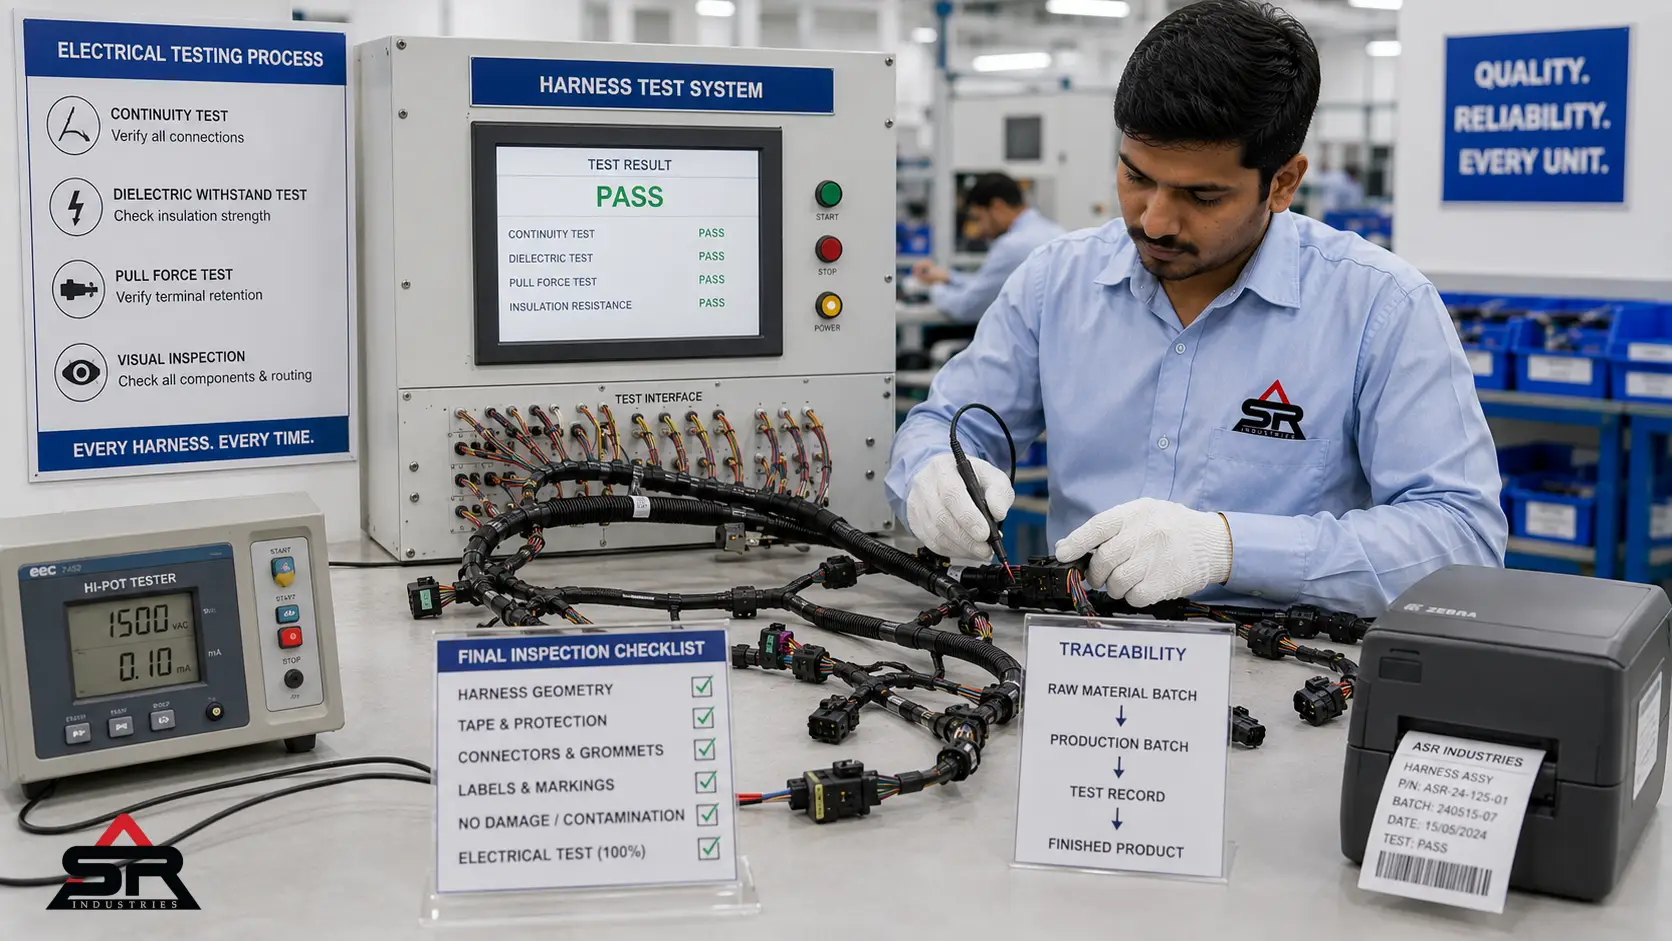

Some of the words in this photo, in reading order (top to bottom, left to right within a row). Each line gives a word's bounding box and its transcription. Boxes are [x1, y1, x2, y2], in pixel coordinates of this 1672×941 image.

[58, 41, 166, 62] ELECTRICAL
[171, 46, 243, 65] TESTING
[248, 49, 324, 67] PROCESS
[1474, 56, 1590, 90] QUALITY.
[540, 76, 632, 96] HARNESS
[637, 78, 685, 98] TEST
[689, 79, 763, 99] SYSTEM
[111, 107, 191, 122] CONTINUITY
[196, 109, 228, 122] TEST
[1454, 102, 1611, 132] RELIABILITY.
[112, 130, 148, 145] Verify
[151, 130, 166, 143] all
[169, 130, 244, 144] connections
[588, 159, 620, 171] TEST
[624, 159, 672, 171] RESULT
[1459, 148, 1539, 176] EVERY
[1543, 146, 1610, 175] UNIT.
[113, 188, 192, 201] DIELECTRIC
[196, 188, 272, 201] WITHSTAND
[276, 188, 307, 201] TEST
[596, 185, 664, 208] PASS
[114, 210, 154, 222] Check
[158, 209, 217, 222] insulation
[221, 210, 271, 224] strength
[816, 213, 839, 221] START
[508, 229, 568, 240] CONTINUITY
[571, 229, 595, 240] TEST
[698, 228, 725, 238] PASS
[509, 253, 566, 264] DIELECTRIC
[568, 252, 593, 264] TEST
[698, 251, 725, 262] PASS
[116, 269, 149, 282] PULL
[153, 269, 197, 281] FORCE
[201, 268, 233, 281] TEST
[698, 274, 725, 285] PASS
[818, 268, 838, 276] STOP
[509, 277, 534, 288] PULL
[538, 277, 569, 288] FORCE
[572, 277, 597, 288] TEST
[116, 290, 152, 305] Verify
[155, 289, 205, 302] terminal
[209, 288, 263, 302] retention
[698, 298, 725, 308] PASS
[509, 301, 568, 312] INSULATION
[572, 300, 632, 311] RESISTANCE
[814, 324, 841, 332] POWER
[118, 353, 165, 366] VISUAL
[169, 350, 246, 364] INSPECTION
[118, 373, 159, 387] Check
[163, 372, 177, 386] all
[180, 371, 256, 388] components
[259, 370, 268, 382] &
[271, 368, 313, 383] routing
[616, 393, 642, 404] TEST
[646, 391, 702, 404] INTERFACE
[73, 441, 128, 458] EVERY
[133, 436, 214, 455] HARNESS.
[219, 433, 270, 450] EVERY
[274, 430, 315, 447] TIME.
[29, 565, 56, 577] eec
[84, 579, 127, 593] HI-POT
[130, 573, 177, 588] TESTER
[1425, 606, 1477, 618] ZEBRA
[110, 604, 168, 638] 1500
[172, 621, 189, 631] VAC
[208, 648, 222, 657] mA
[458, 648, 506, 664] FINAL
[511, 644, 610, 661] INSPECTION
[614, 640, 705, 658] CHECKLIST
[1060, 642, 1187, 661] TRACEABILITY
[119, 648, 172, 682] 0.10
[177, 663, 192, 674] mA
[459, 686, 528, 701] HARNESS
[533, 684, 614, 699] GEOMETRY
[1048, 684, 1078, 696] RAW
[1082, 685, 1148, 699] MATERIAL
[1152, 688, 1197, 702] BATCH
[459, 718, 495, 732] TAPE
[500, 718, 510, 730] &
[514, 715, 608, 730] PROTECTION
[1050, 734, 1139, 750] PRODUCTION
[1144, 739, 1189, 752] BATCH
[459, 749, 560, 764] CONNECTORS
[566, 748, 575, 760] &
[580, 744, 664, 760] GROMMETS
[1412, 742, 1440, 755] ASR
[1442, 746, 1524, 768] INDUSTRIES
[1404, 762, 1460, 780] HARNESS
[1462, 771, 1494, 785] ASSY
[459, 782, 516, 797] LABELS
[521, 780, 530, 793] &
[535, 778, 616, 794] MARKINGS
[1070, 785, 1104, 799] TEST
[1108, 788, 1166, 803] RECORD
[1398, 778, 1422, 794] P/N:
[1392, 796, 1434, 813] BATCH:
[1436, 804, 1498, 822] 240515-07
[459, 816, 482, 830] NO
[485, 813, 550, 829] DAMAGE
[564, 808, 686, 826] CONTAMINATION
[1387, 814, 1422, 830] DATE:
[1426, 820, 1488, 841] 15/05/2024
[1048, 838, 1112, 854] FINISHED
[1116, 842, 1184, 859] PRODUCT
[1384, 833, 1415, 850] TEST:
[1418, 838, 1448, 854] PASS
[459, 848, 551, 865] ELECTRICAL
[556, 846, 593, 862] TEST
[598, 845, 646, 862] (100%)
